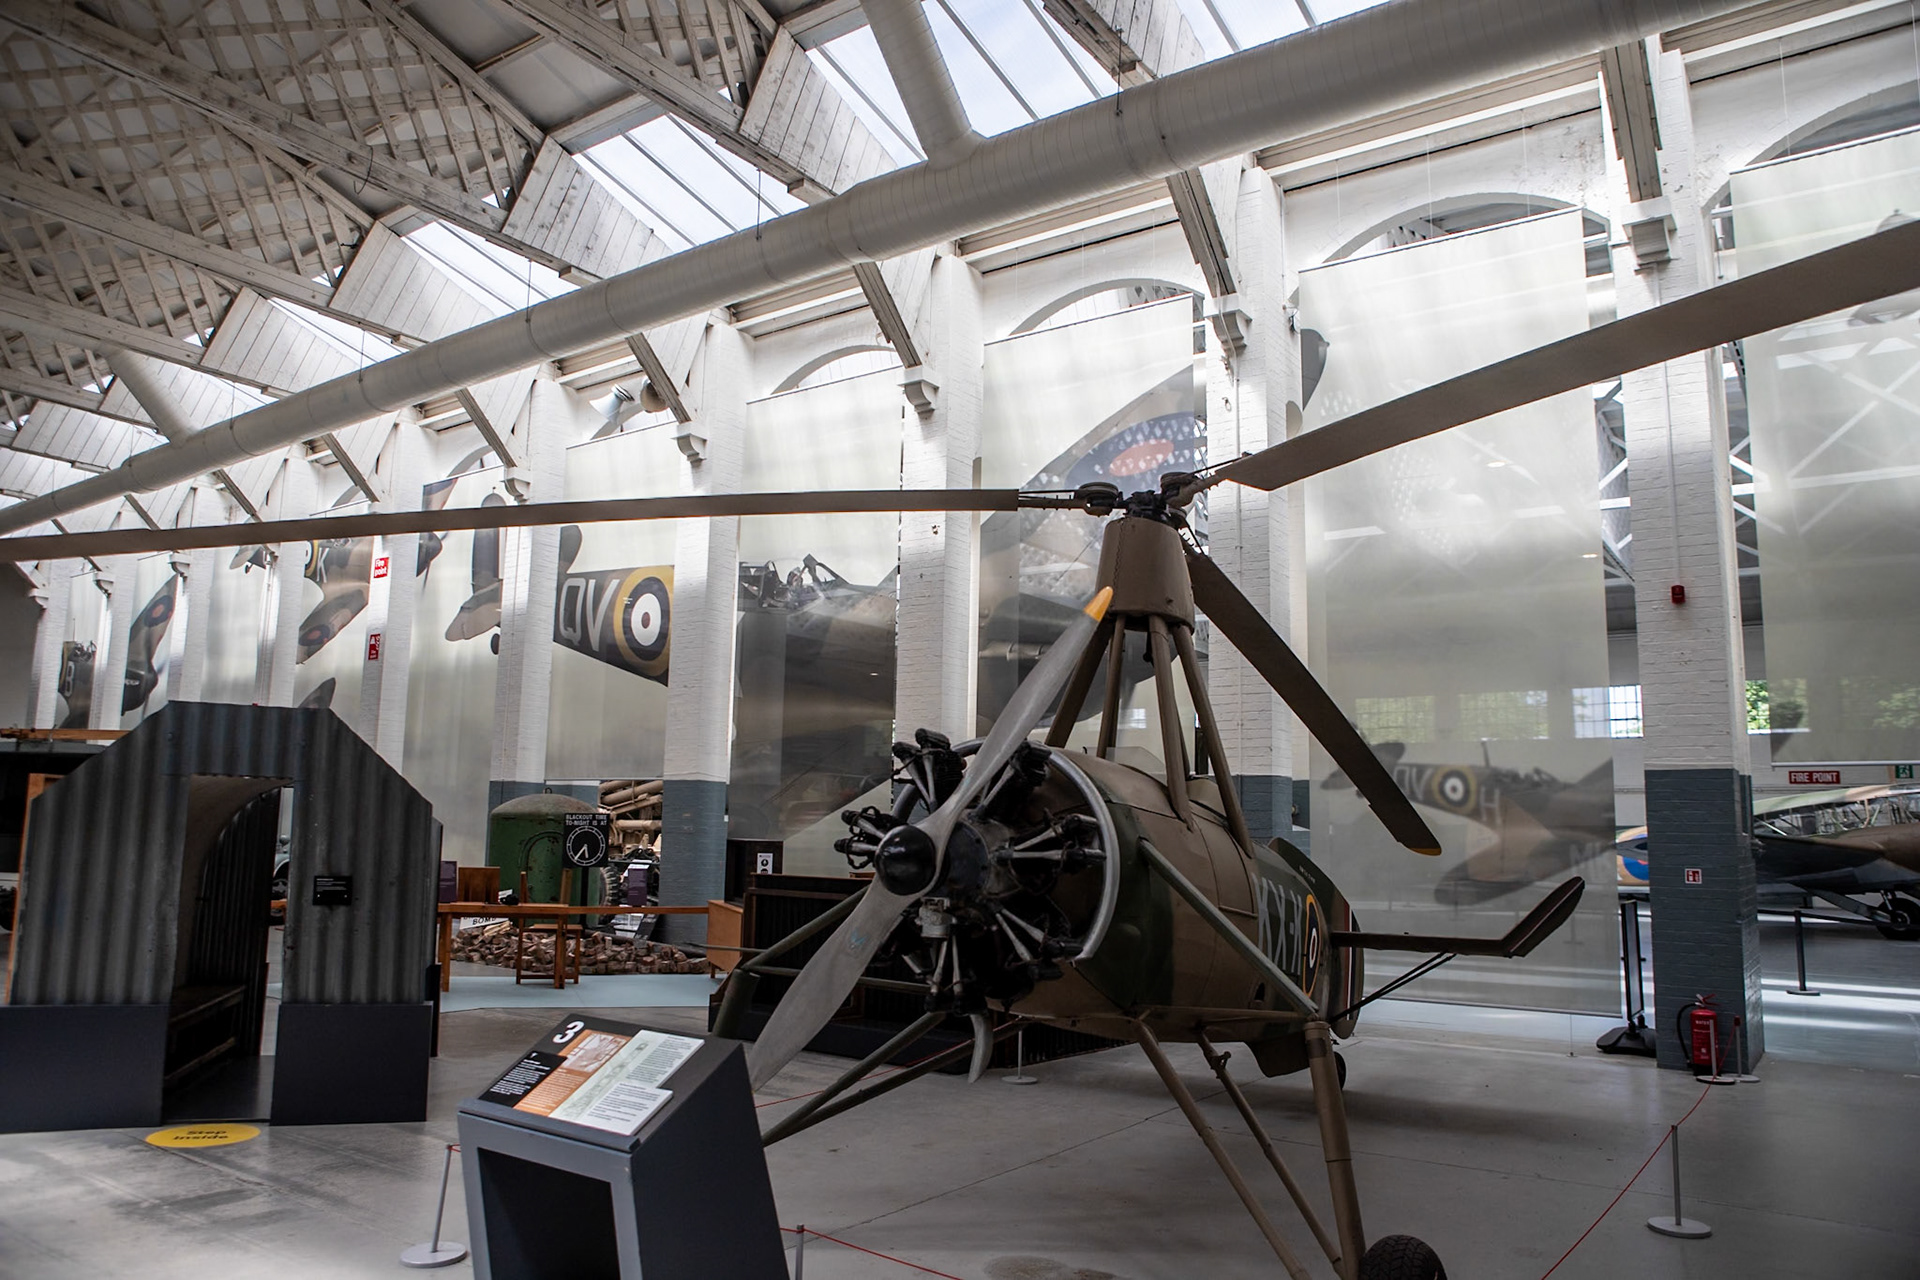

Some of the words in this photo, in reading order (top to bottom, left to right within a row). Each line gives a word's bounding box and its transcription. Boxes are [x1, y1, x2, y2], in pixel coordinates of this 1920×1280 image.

[375, 559, 385, 568] Fire
[374, 567, 387, 577] point
[559, 577, 621, 652] QV
[1790, 772, 1809, 782] FIRE
[1812, 772, 1838, 782] POINT
[552, 1020, 585, 1044] 3
